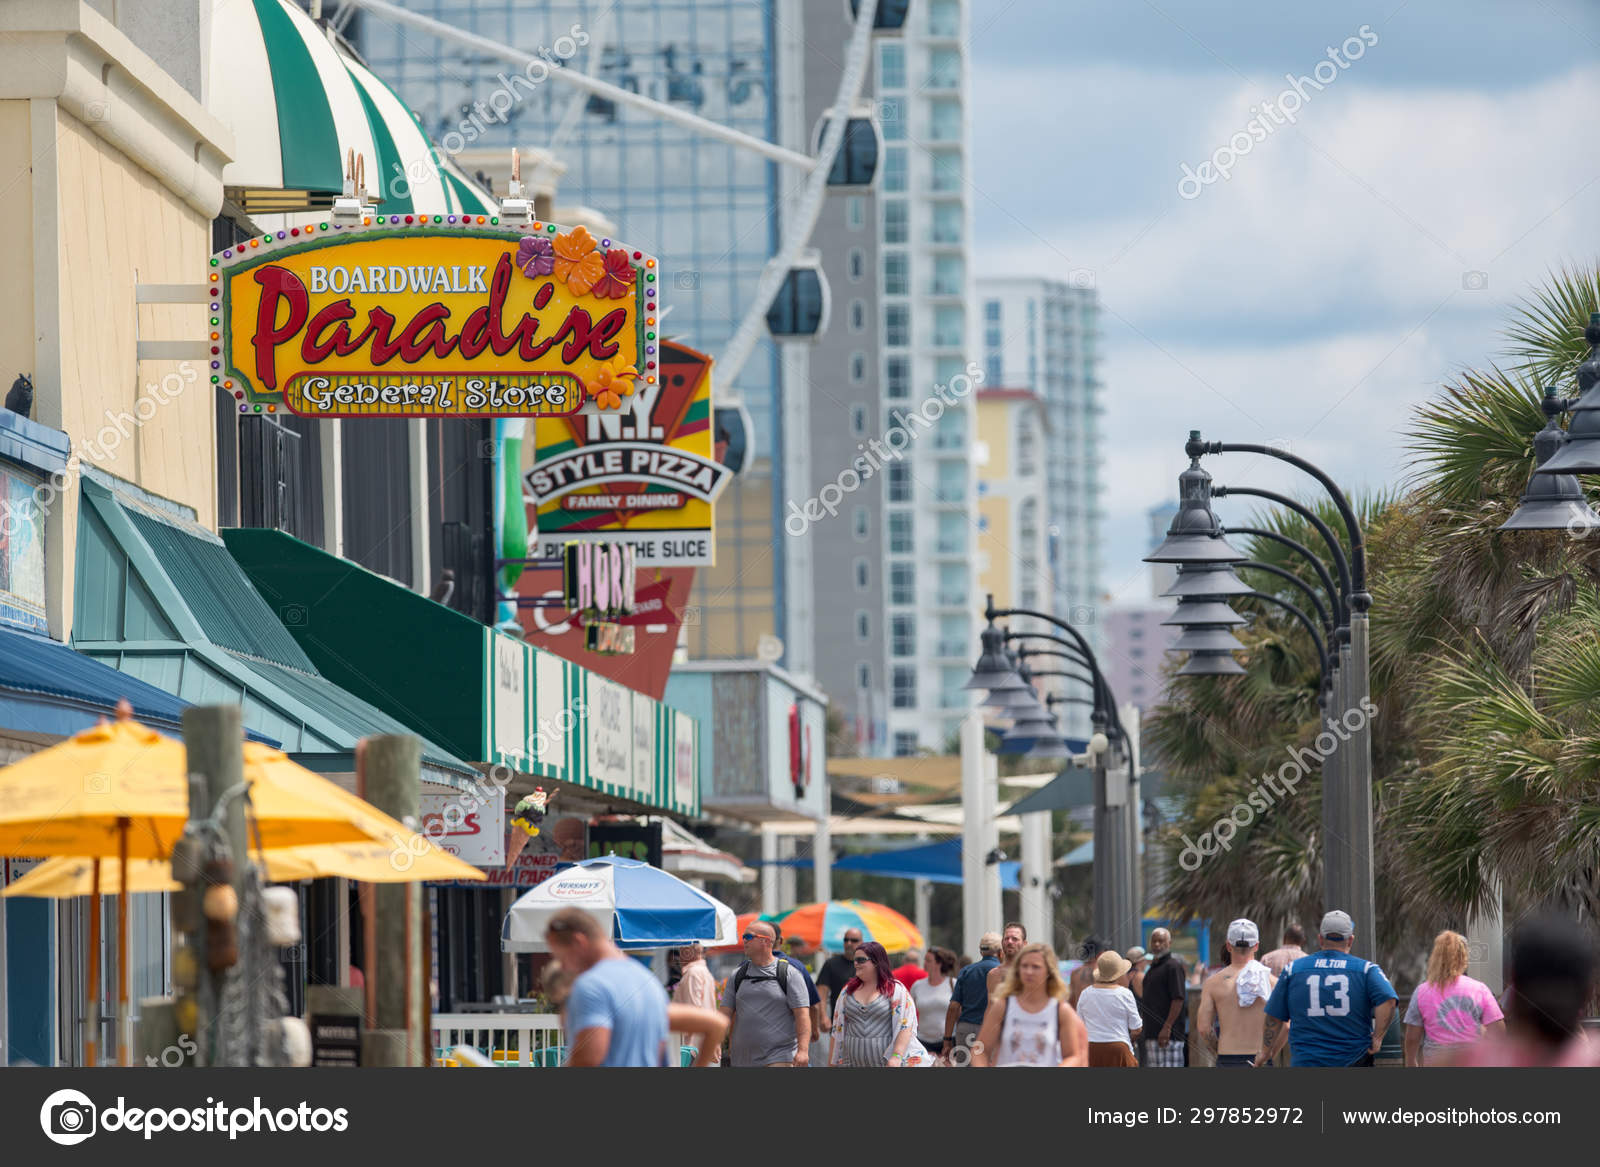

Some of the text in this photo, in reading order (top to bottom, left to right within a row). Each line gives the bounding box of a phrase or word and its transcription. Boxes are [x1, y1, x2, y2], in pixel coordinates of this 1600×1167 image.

[310, 266, 488, 295] BOARDWALK
[251, 251, 627, 391] Paradise
[302, 377, 568, 409] General Store
[529, 450, 715, 494] STYLE PIZZA
[568, 494, 679, 508] FAMILY DINING
[662, 540, 707, 558] SLICE
[1314, 958, 1347, 969] HILTON
[1306, 974, 1350, 1017] 13
